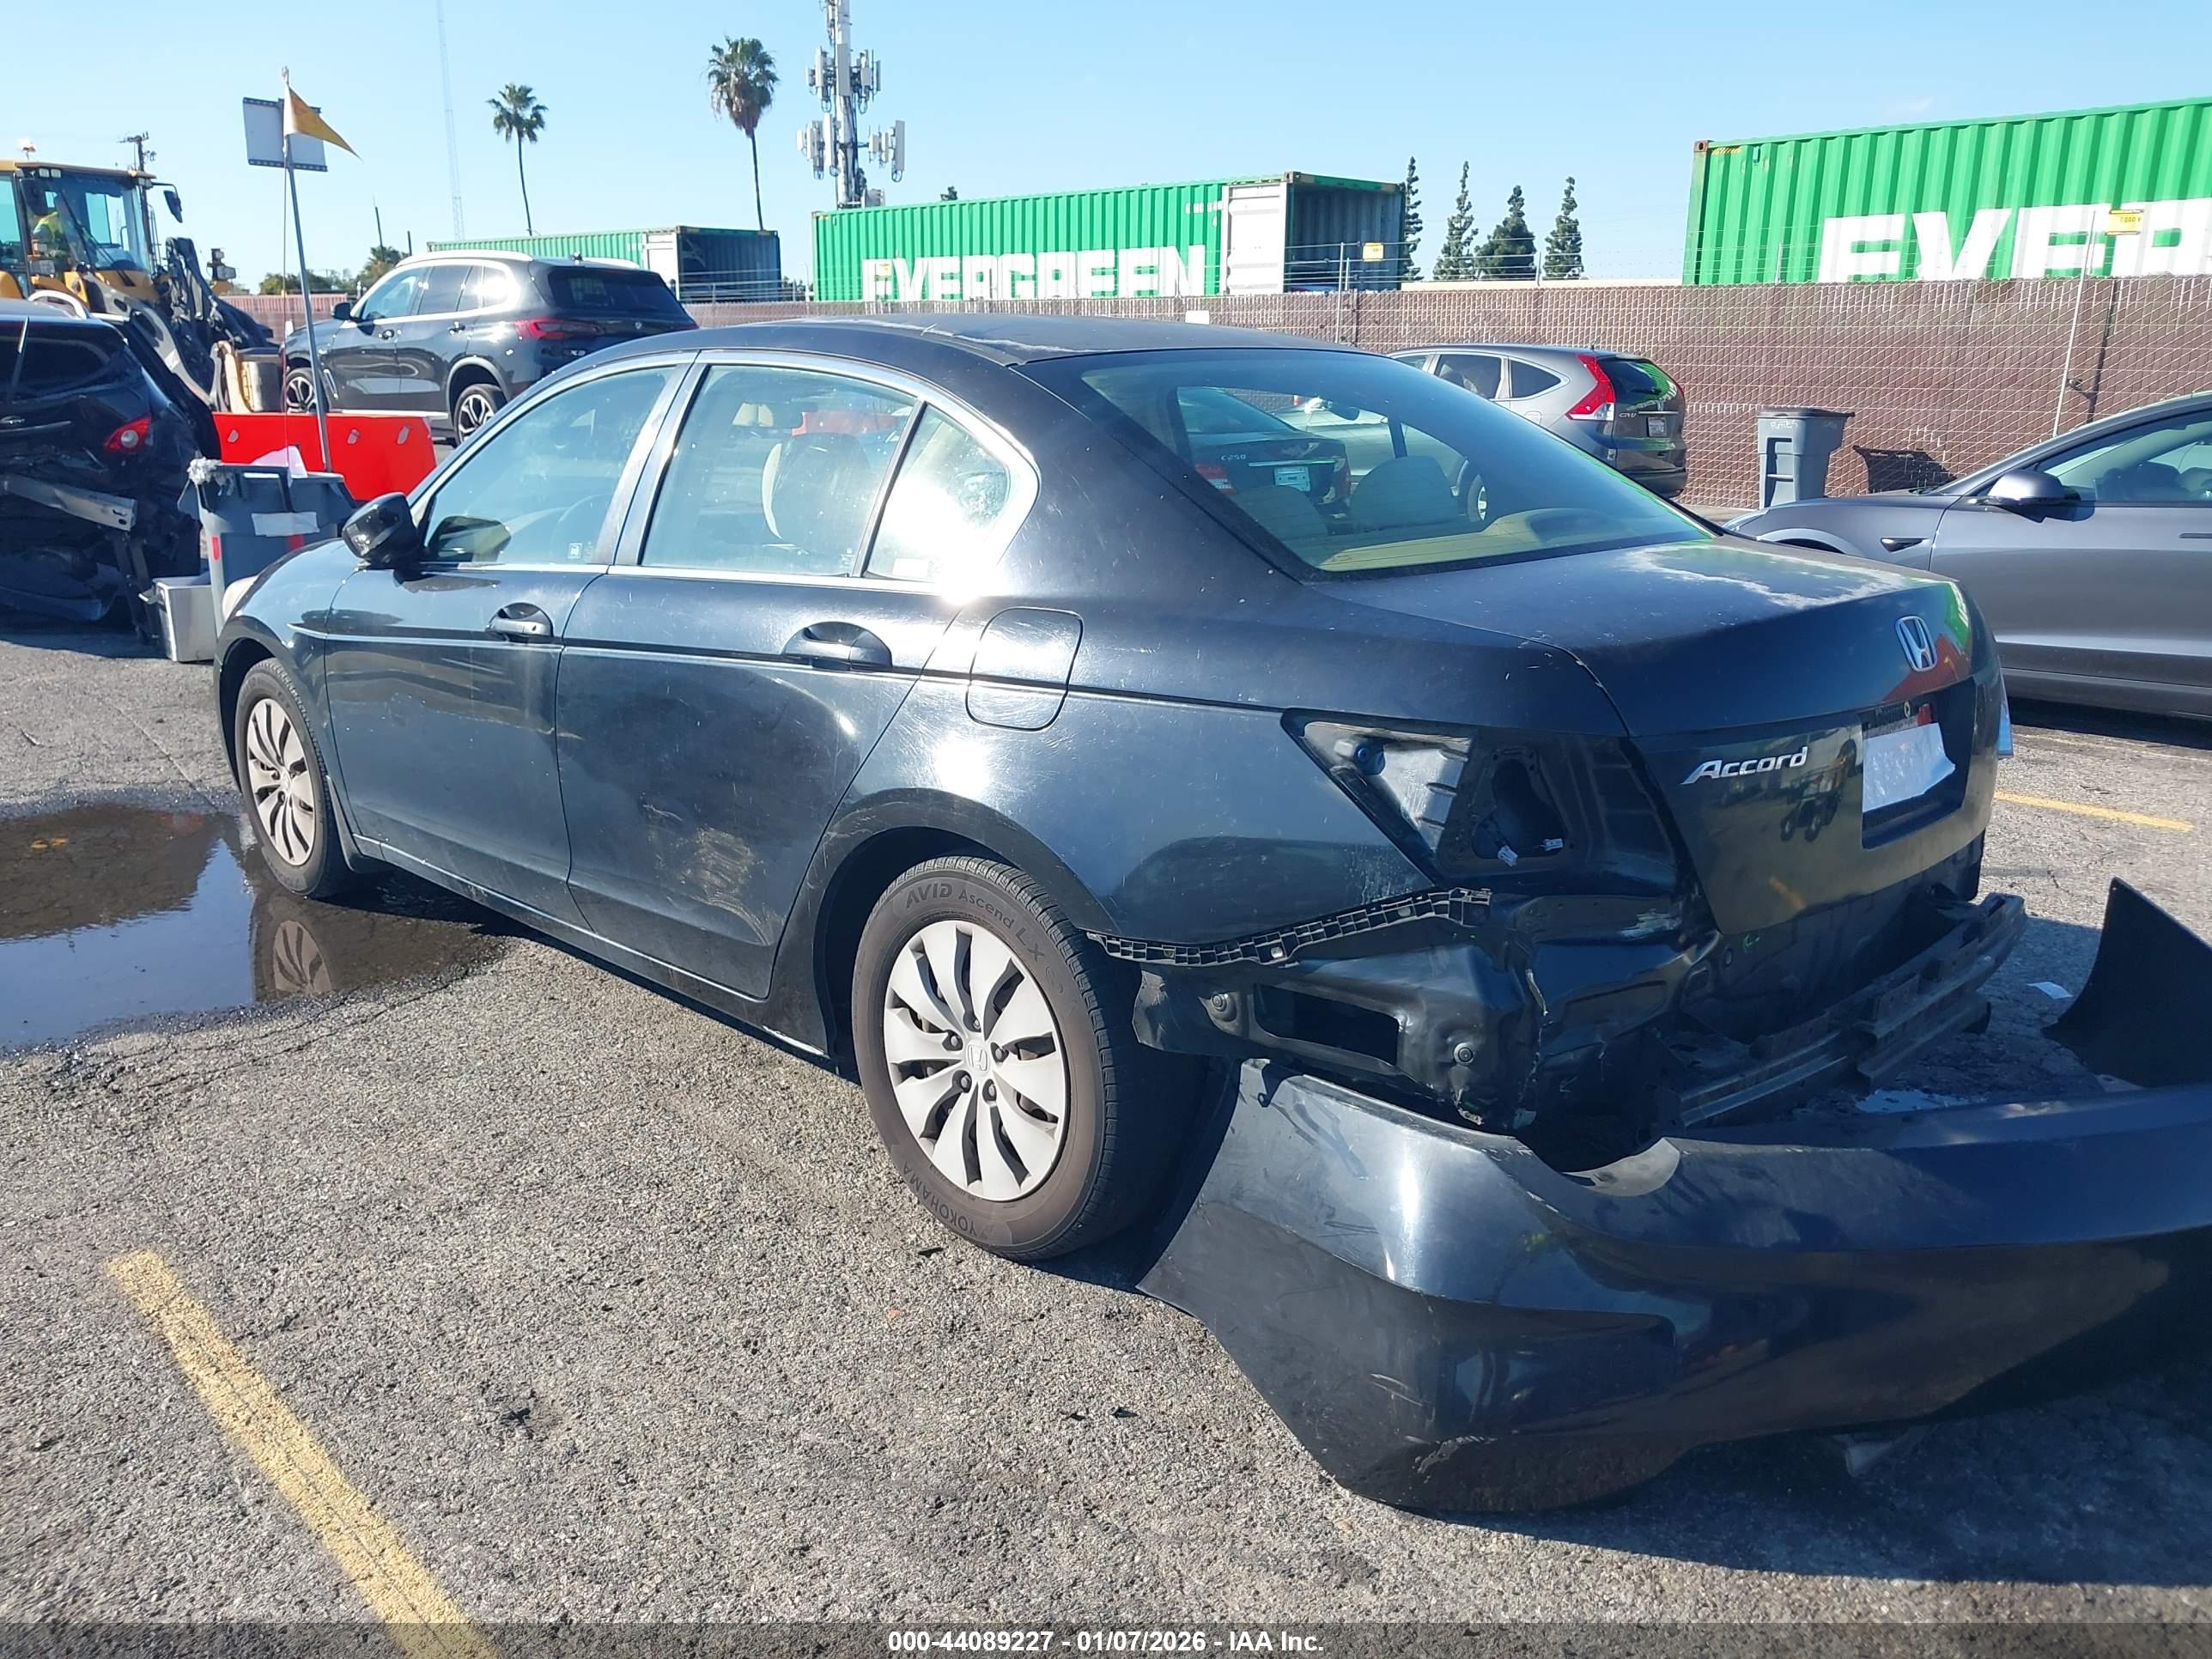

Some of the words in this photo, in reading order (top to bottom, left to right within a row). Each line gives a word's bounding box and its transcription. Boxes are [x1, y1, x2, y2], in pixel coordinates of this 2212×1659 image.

[862, 245, 1206, 303] EVERGREEN
[1680, 745, 1808, 785] Accord
[906, 882, 953, 908] AVID
[958, 889, 1015, 929] Ascend
[1015, 926, 1046, 963] LX
[903, 1160, 976, 1236] YOKOHAMA
